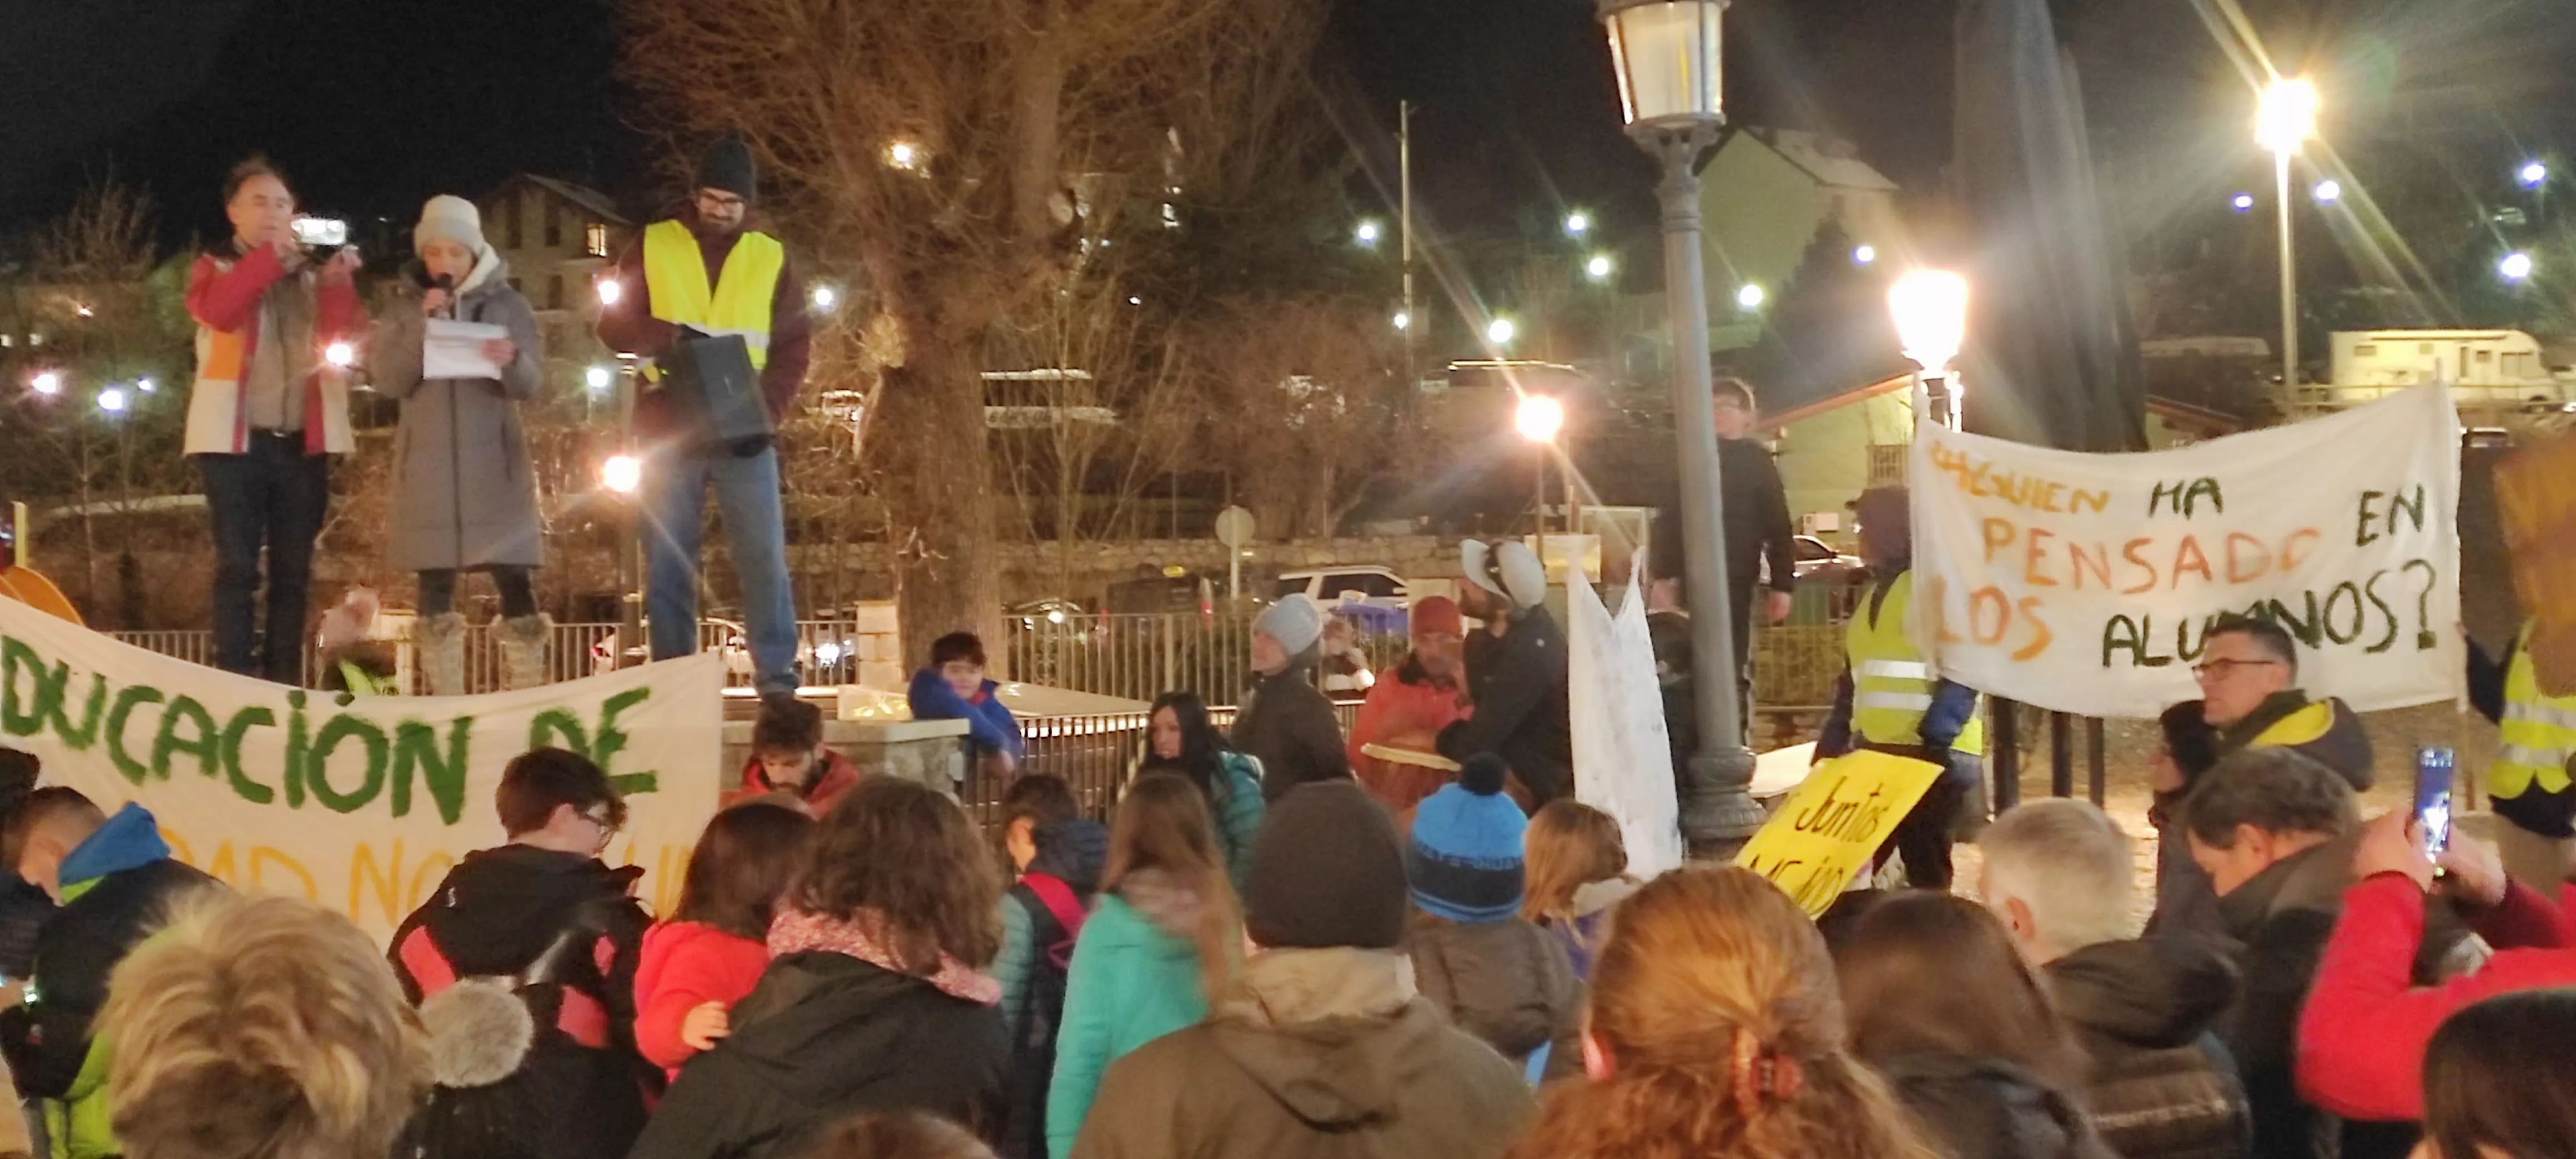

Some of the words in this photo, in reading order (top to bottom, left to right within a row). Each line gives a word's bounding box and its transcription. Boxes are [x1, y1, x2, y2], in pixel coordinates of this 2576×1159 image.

[2150, 476, 2224, 520] HA
[2356, 482, 2424, 547] EN
[1929, 575, 2053, 662] LOS
